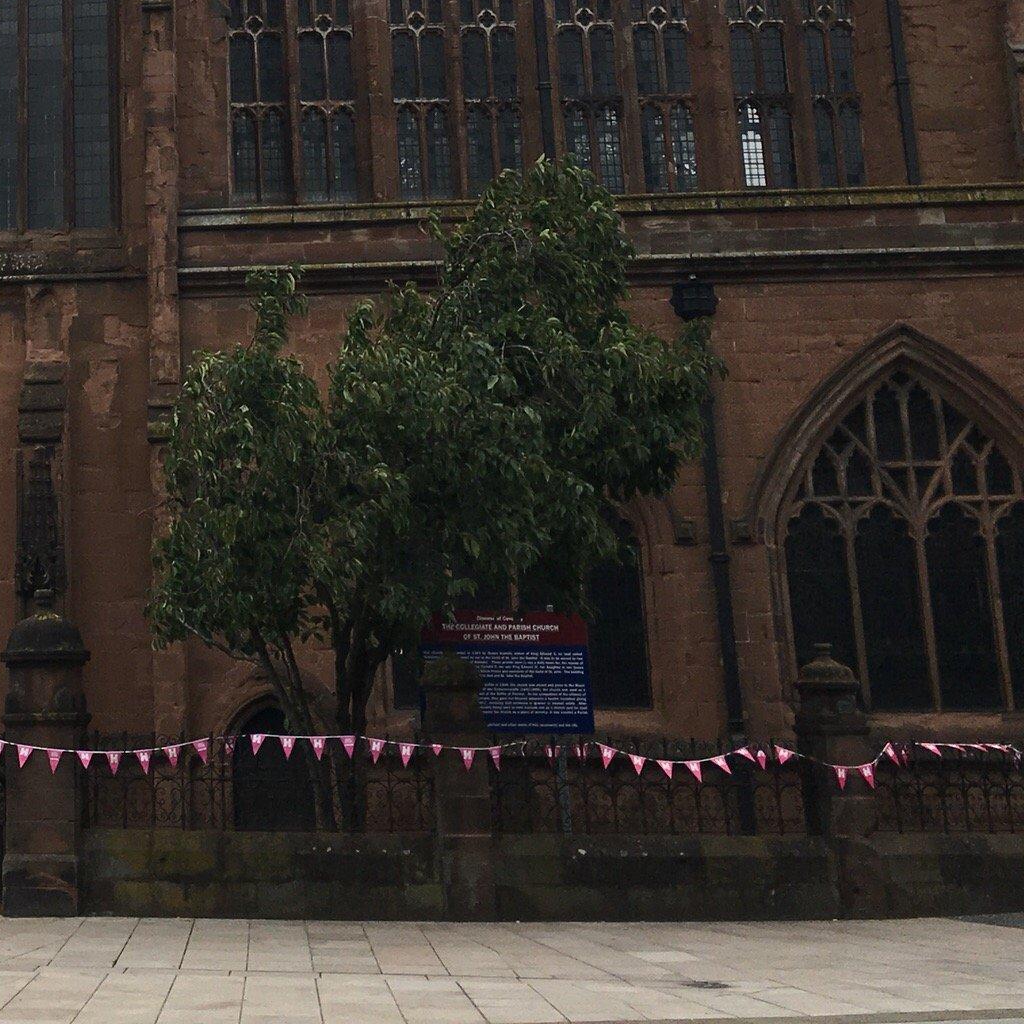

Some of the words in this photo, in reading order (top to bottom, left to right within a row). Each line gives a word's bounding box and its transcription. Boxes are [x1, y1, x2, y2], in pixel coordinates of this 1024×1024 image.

[508, 624, 532, 632] PARISH
[532, 624, 559, 632] CHURCH
[483, 633, 500, 641] JOHN
